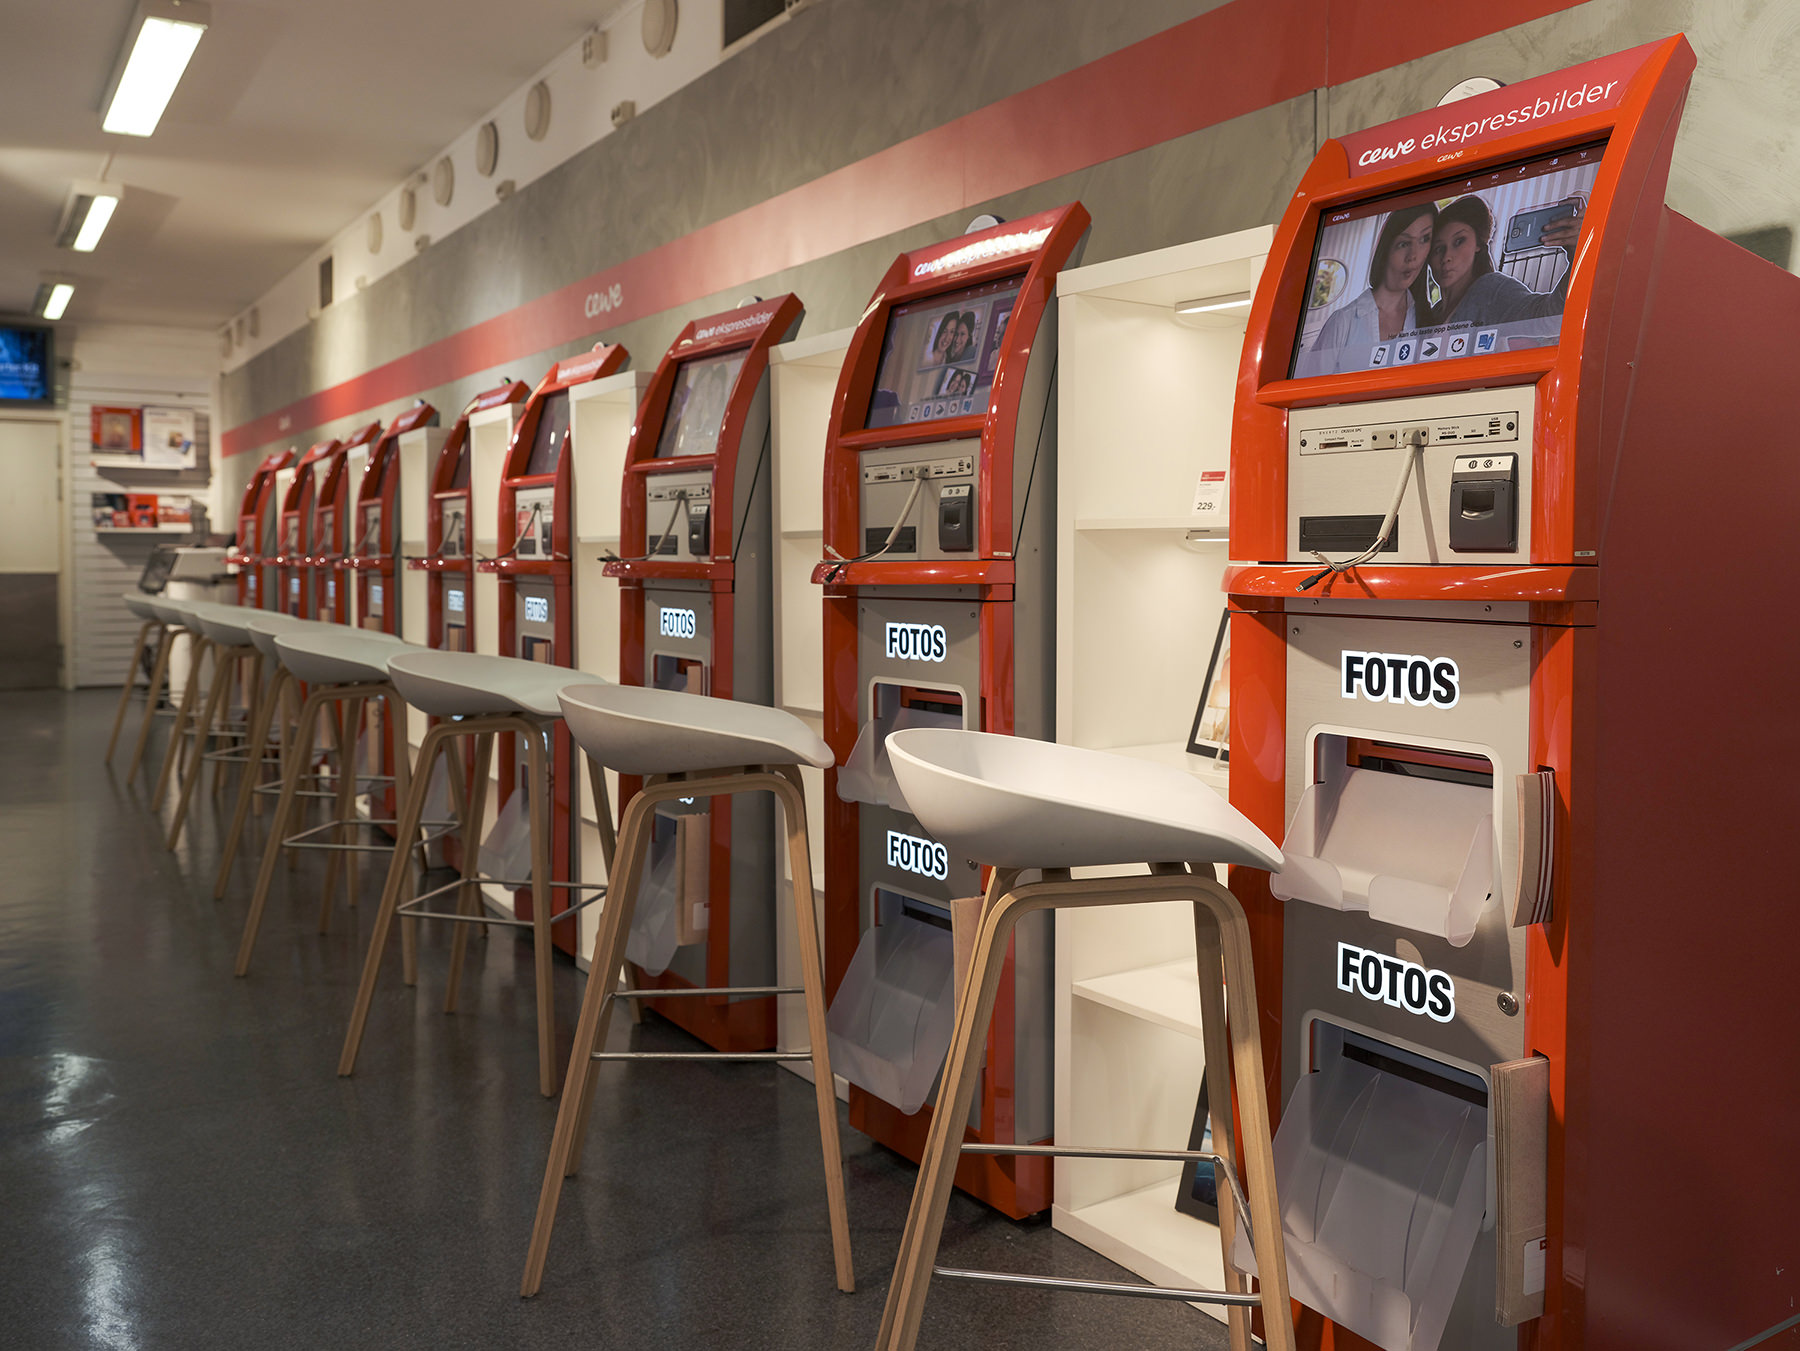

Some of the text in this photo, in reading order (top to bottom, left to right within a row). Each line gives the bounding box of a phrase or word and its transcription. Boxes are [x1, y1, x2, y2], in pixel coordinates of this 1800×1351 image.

[1358, 80, 1618, 167] cewe ekspressbilder
[1436, 149, 1464, 163] cewe
[585, 283, 624, 319] cewe
[662, 610, 695, 636] FOTOS
[888, 626, 945, 659] FOTOS
[1345, 654, 1457, 705] FOTOS
[889, 833, 946, 877] FOTOS
[1341, 946, 1452, 1018] FOTOS
